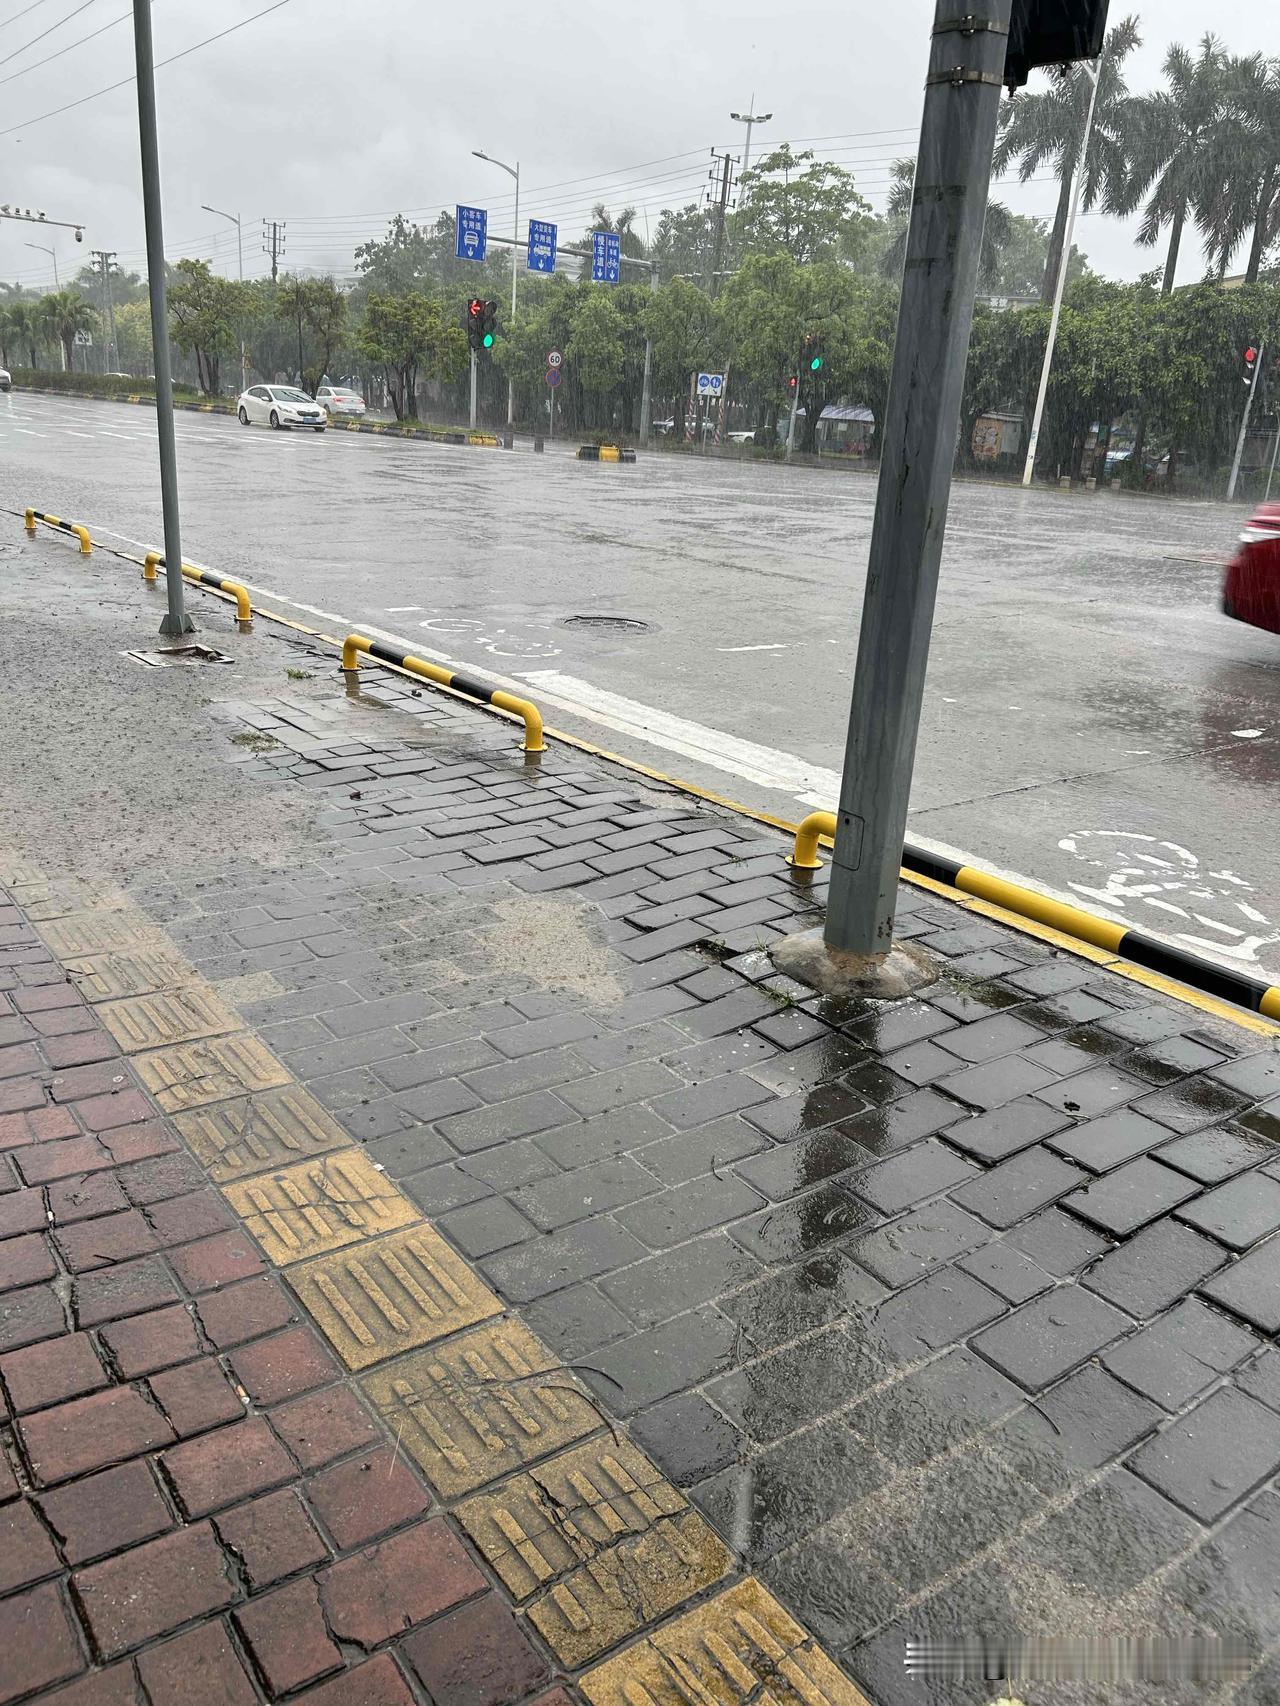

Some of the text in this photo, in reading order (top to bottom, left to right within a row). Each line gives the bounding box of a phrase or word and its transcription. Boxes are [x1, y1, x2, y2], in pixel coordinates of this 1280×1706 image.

[462, 209, 481, 220] 小客车
[462, 220, 481, 230] 专用道
[550, 355, 560, 364] 60
